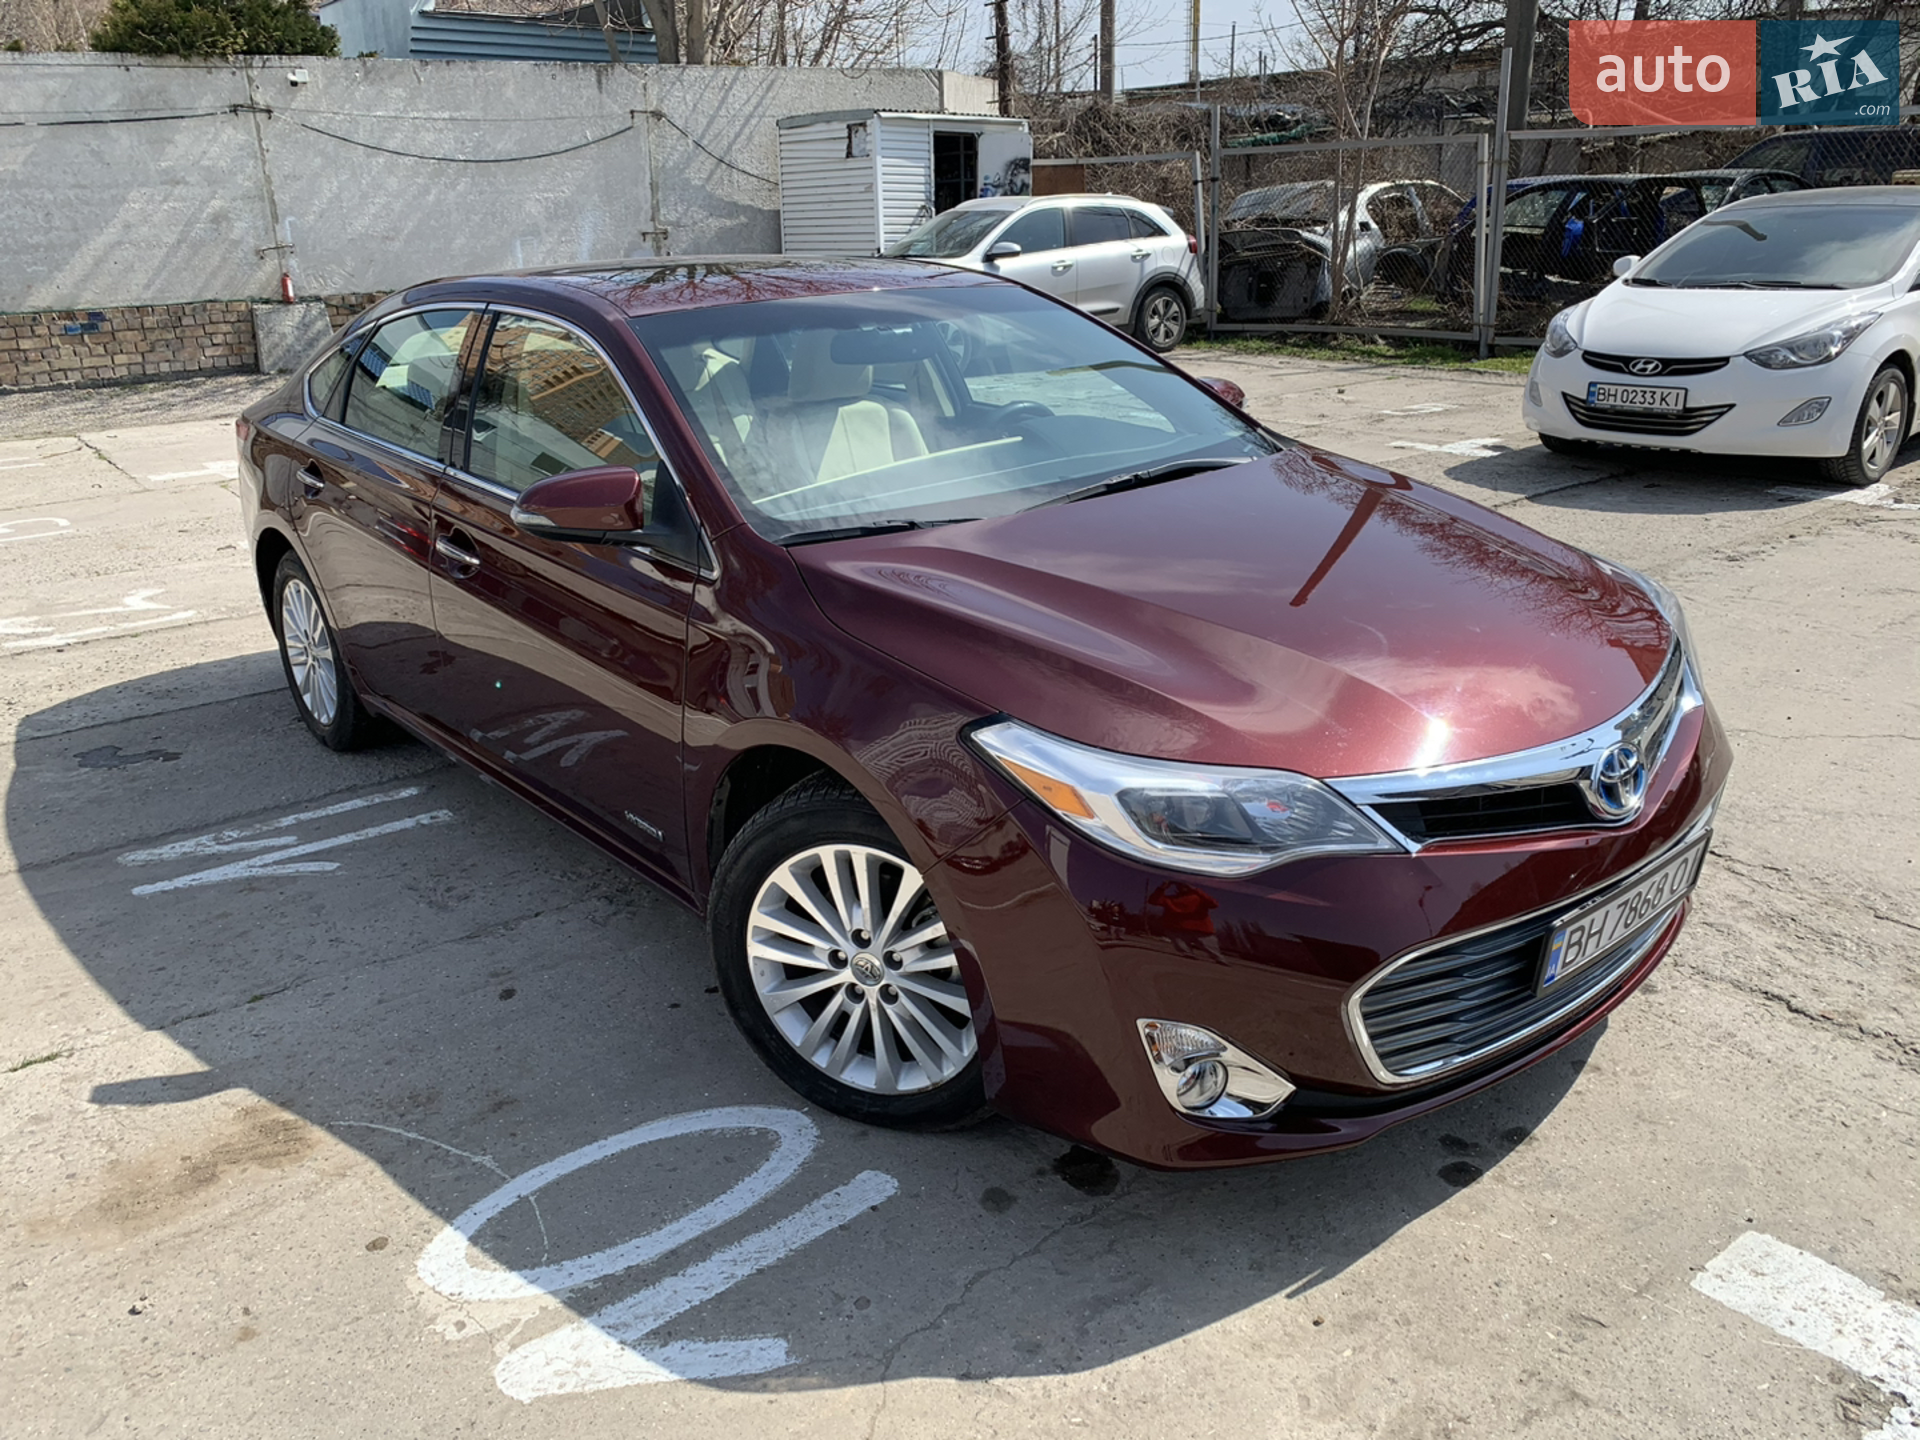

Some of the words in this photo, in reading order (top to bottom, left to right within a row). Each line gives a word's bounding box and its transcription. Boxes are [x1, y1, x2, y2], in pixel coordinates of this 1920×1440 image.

[1596, 387, 1618, 403] BH
[1620, 389, 1657, 406] 0233
[1659, 391, 1680, 407] KI
[1561, 910, 1610, 970] BH
[1608, 872, 1669, 941] 7868
